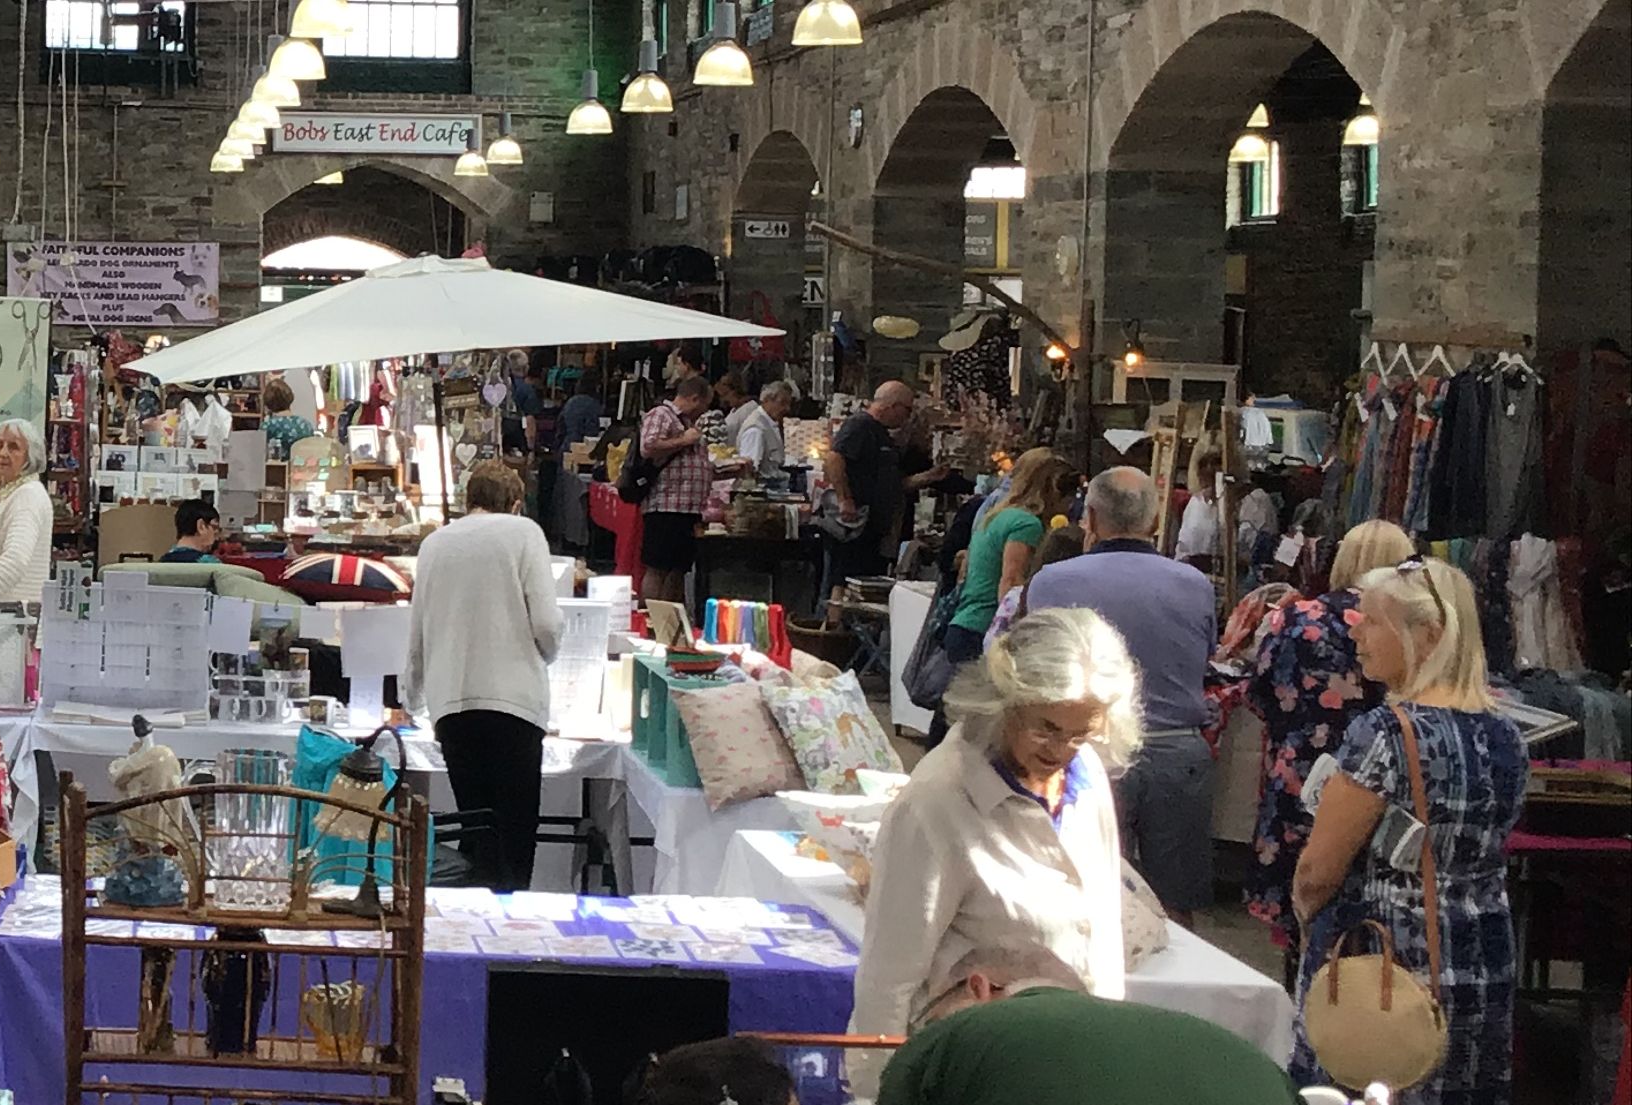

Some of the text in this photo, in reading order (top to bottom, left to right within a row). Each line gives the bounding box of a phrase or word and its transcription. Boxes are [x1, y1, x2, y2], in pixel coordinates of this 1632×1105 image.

[282, 121, 469, 146] Bobs East End Cafe
[42, 244, 186, 257] FAITFUL COMPANIONS
[99, 259, 120, 269] DOG
[122, 260, 180, 269] ORNAMENTS
[101, 270, 126, 279] ALSO
[121, 282, 162, 290] WOODEN
[93, 292, 116, 301] AND
[116, 292, 140, 301] LEAD
[141, 292, 186, 301] HANGERS
[101, 303, 125, 312] PLUS
[103, 315, 124, 323] DOG
[125, 315, 153, 323] SIGNS
